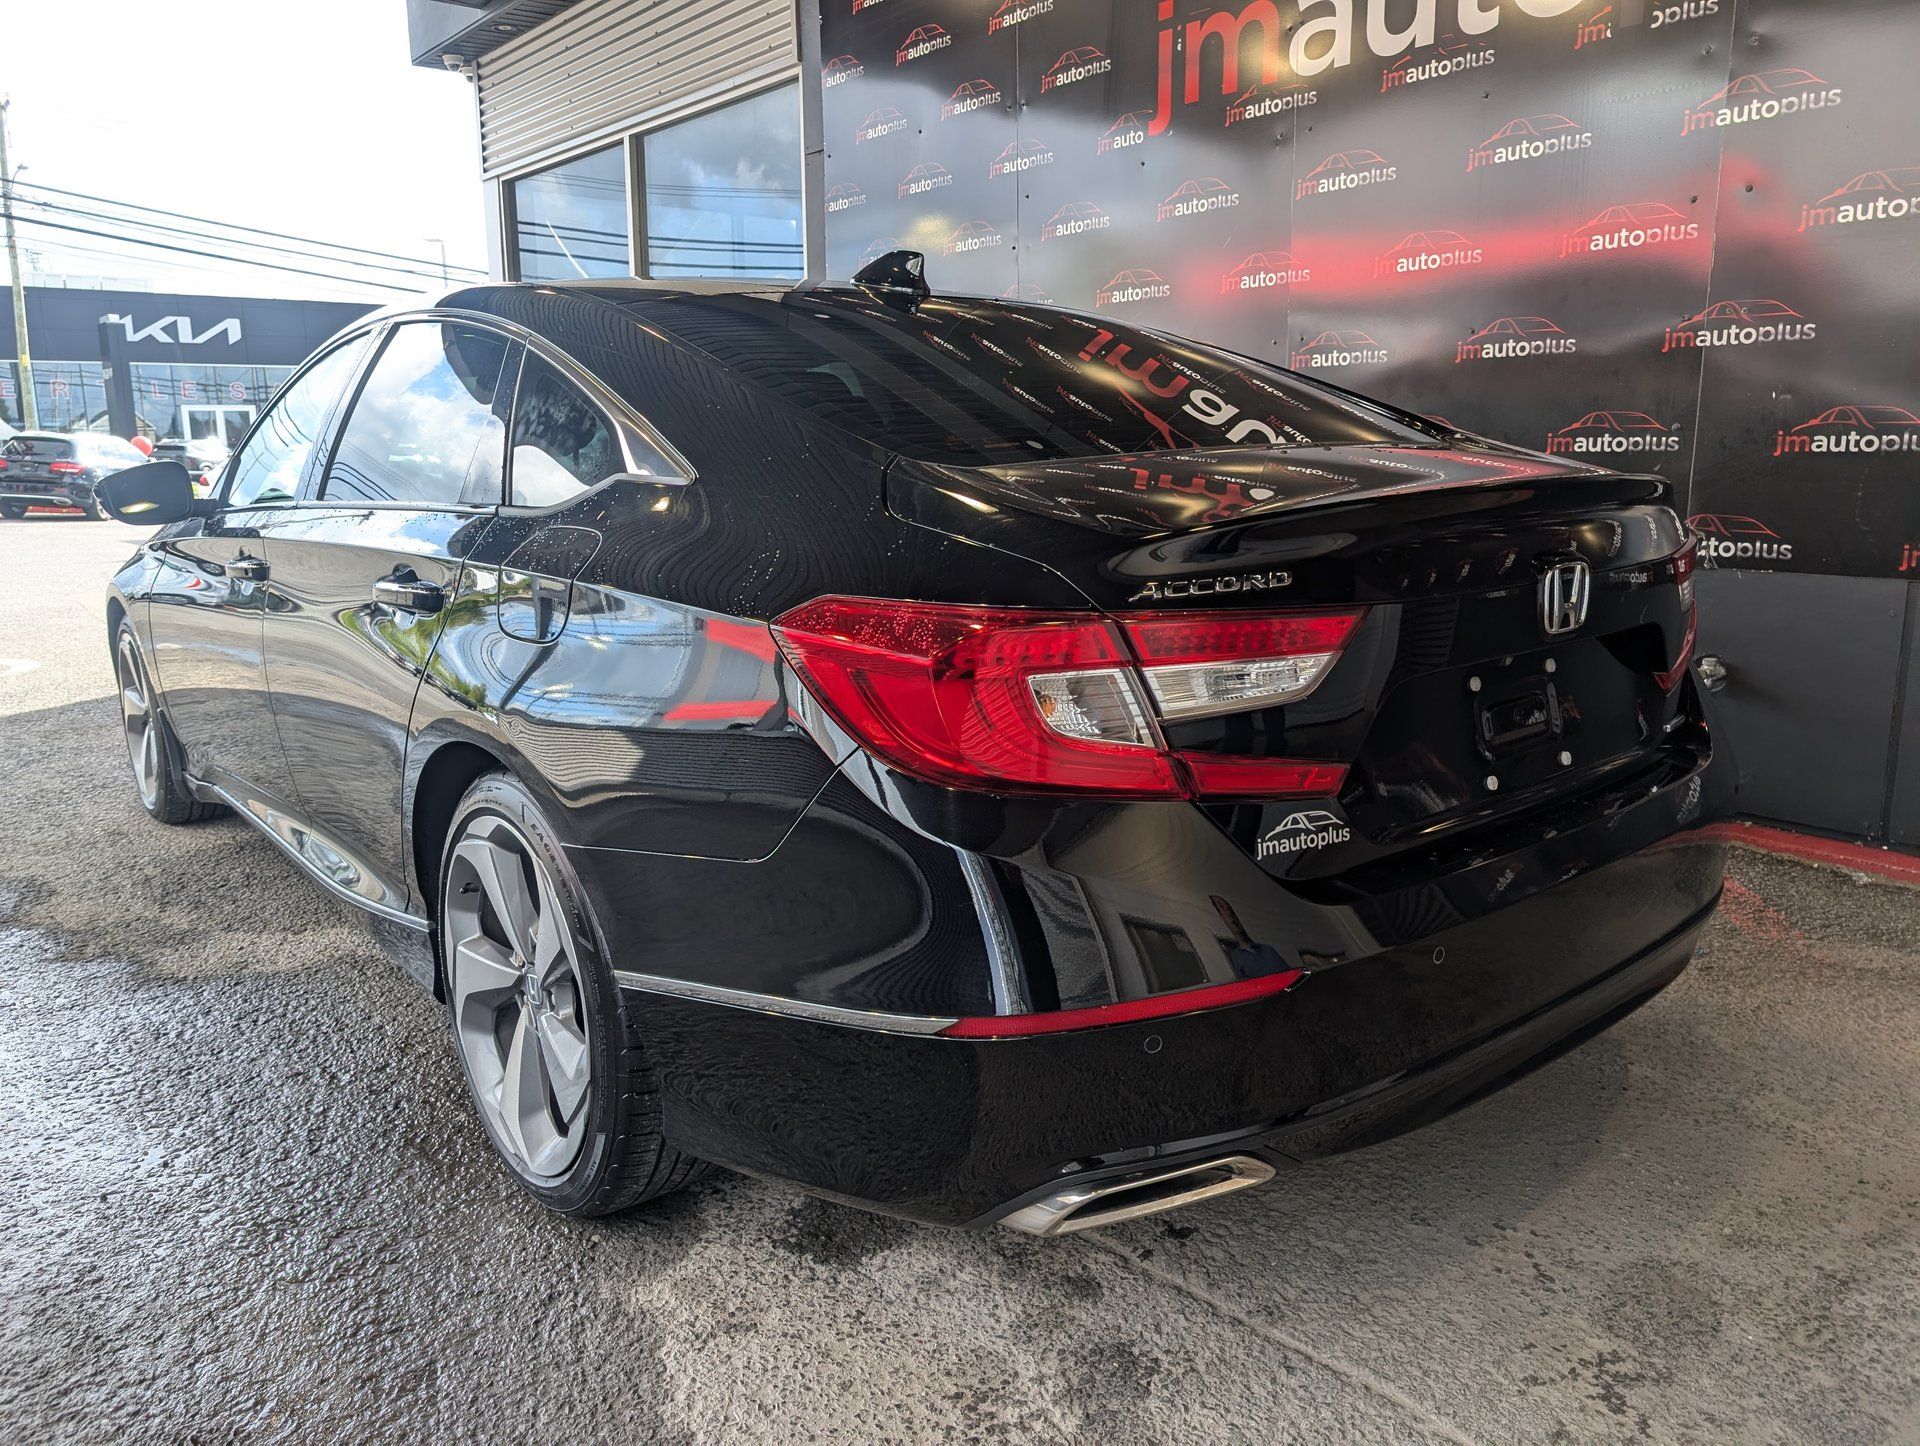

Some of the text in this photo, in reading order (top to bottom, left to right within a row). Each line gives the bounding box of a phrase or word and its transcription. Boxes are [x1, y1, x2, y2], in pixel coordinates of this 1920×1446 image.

[988, 0, 1054, 35] jmautoplus
[896, 34, 952, 67] jmautoplus
[1041, 58, 1112, 94] jmautoplus
[1148, 0, 1586, 136] jmau
[1381, 48, 1496, 94] jmautoplus
[941, 90, 1001, 121] jmautoplus
[1225, 89, 1318, 127] jmautoplus
[1681, 87, 1842, 136] jmautoplus
[856, 117, 907, 145] jmautoplus
[989, 151, 1054, 179] jmautoplus
[1466, 131, 1593, 172] jmautoplus
[897, 173, 953, 199] jmautoplus
[1296, 165, 1398, 200] jmautoplus
[1157, 192, 1240, 222] jmautoplus
[1041, 213, 1110, 242] jmautoplus
[1560, 221, 1699, 258] jmautoplus
[943, 233, 1002, 257] jmautoplus
[1373, 247, 1483, 278] jmautoplus
[1095, 283, 1171, 308] jmautoplus
[1220, 267, 1311, 294] jmautoplus
[119, 314, 242, 345] KIA
[1662, 320, 1817, 353] jmautoplus
[1290, 348, 1388, 371] jmautoplus
[1456, 336, 1577, 364] jmautoplus
[1545, 431, 1680, 455] jmautoplus
[1128, 571, 1293, 603] ACCORD
[1256, 826, 1351, 861] jmautoplus
